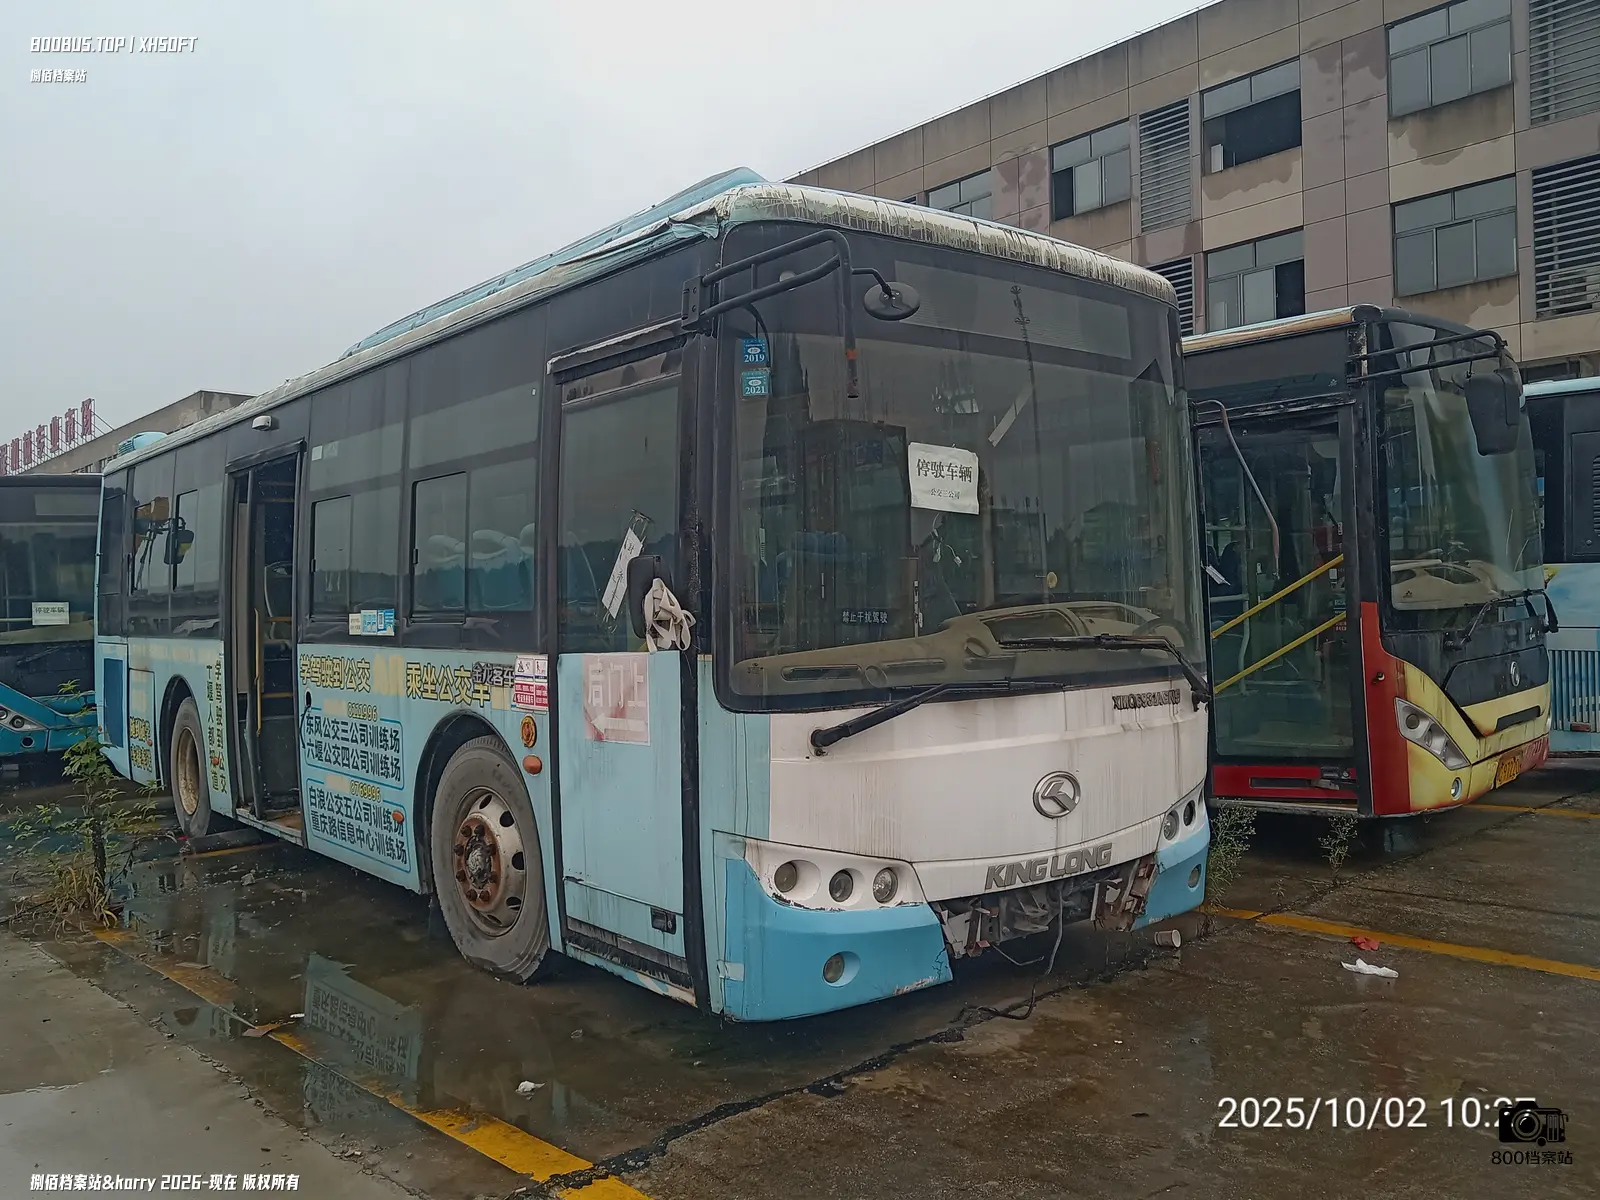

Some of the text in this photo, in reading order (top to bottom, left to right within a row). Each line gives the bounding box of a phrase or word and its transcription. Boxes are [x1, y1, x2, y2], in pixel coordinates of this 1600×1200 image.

[744, 354, 765, 363] 2019
[745, 386, 765, 395] 2021
[916, 458, 972, 483] 停驶车辆
[930, 488, 961, 500] 公交三公司
[842, 610, 888, 624] 禁止干扰驾驶
[300, 654, 371, 693] 学驾驶到公交
[306, 714, 400, 754] 东风公交三公司训练场
[306, 739, 401, 782] 六堰公交四公司训练场
[308, 786, 404, 837] 白浪公交五公司训练场
[311, 810, 407, 865] 重庆路信息中心训练场
[984, 842, 1112, 890] KING LONG
